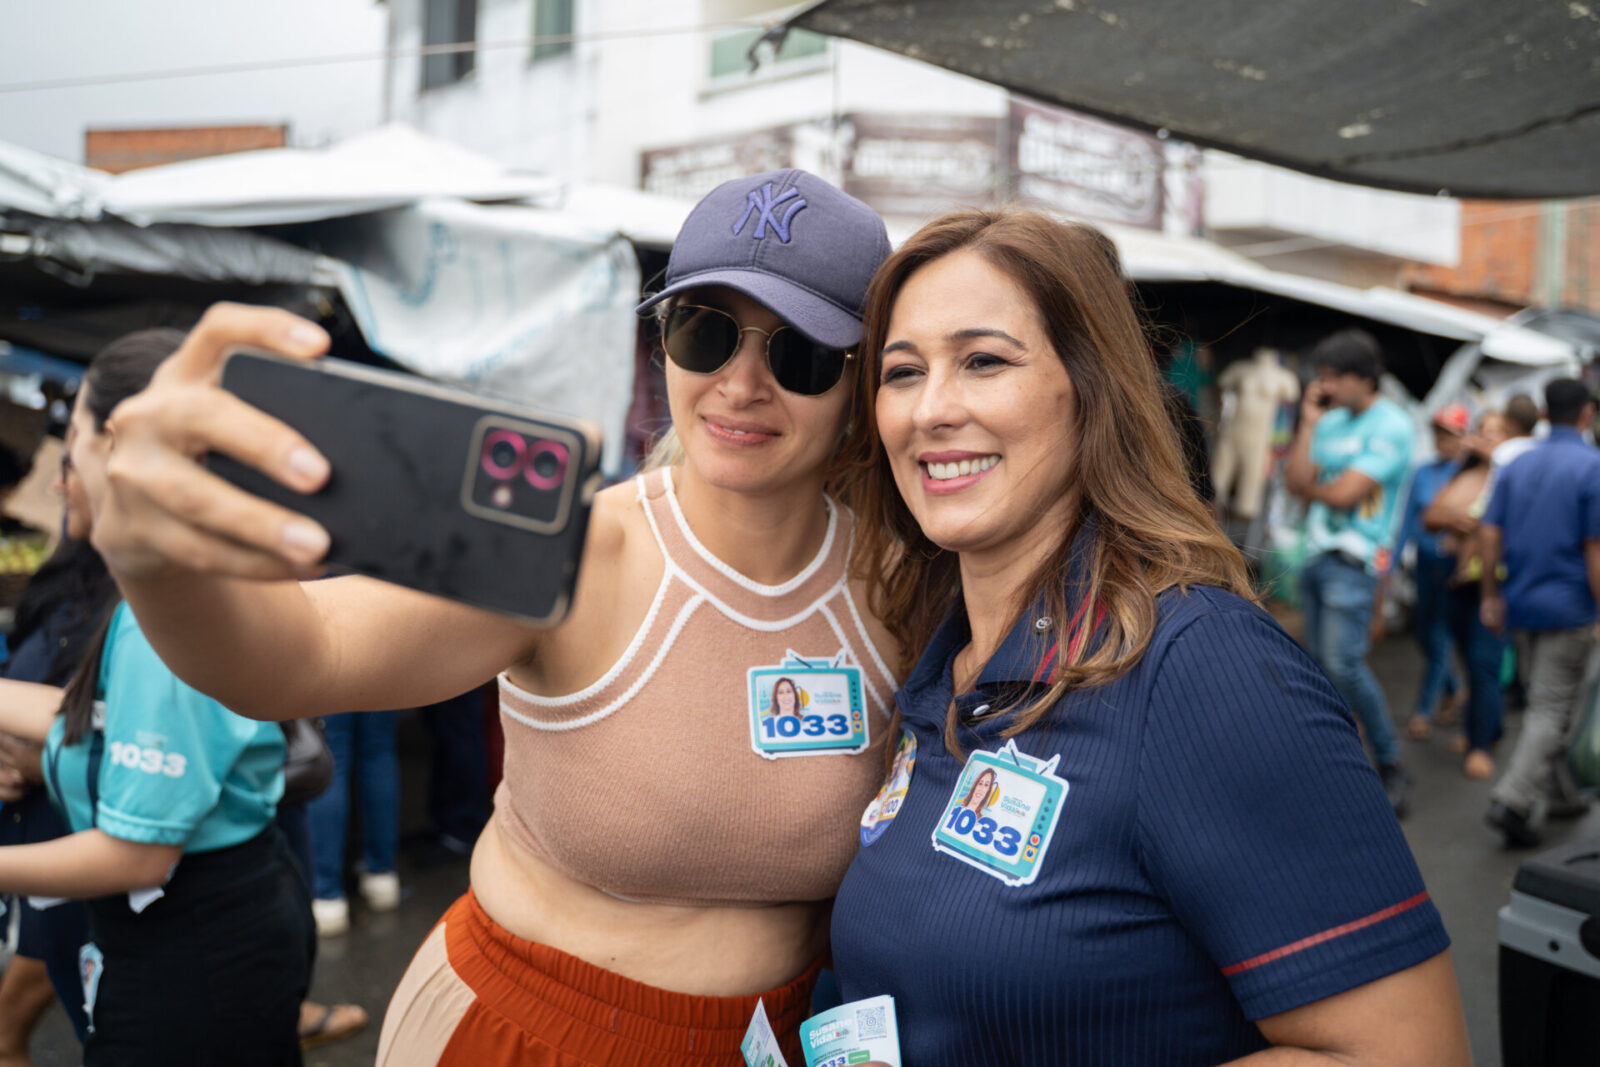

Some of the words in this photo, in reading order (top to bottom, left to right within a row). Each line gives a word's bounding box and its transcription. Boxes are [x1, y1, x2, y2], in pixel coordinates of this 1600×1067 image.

[732, 182, 808, 244] NY
[762, 714, 849, 738] 1033
[110, 741, 187, 778] 1033
[946, 806, 1022, 856] 1033
